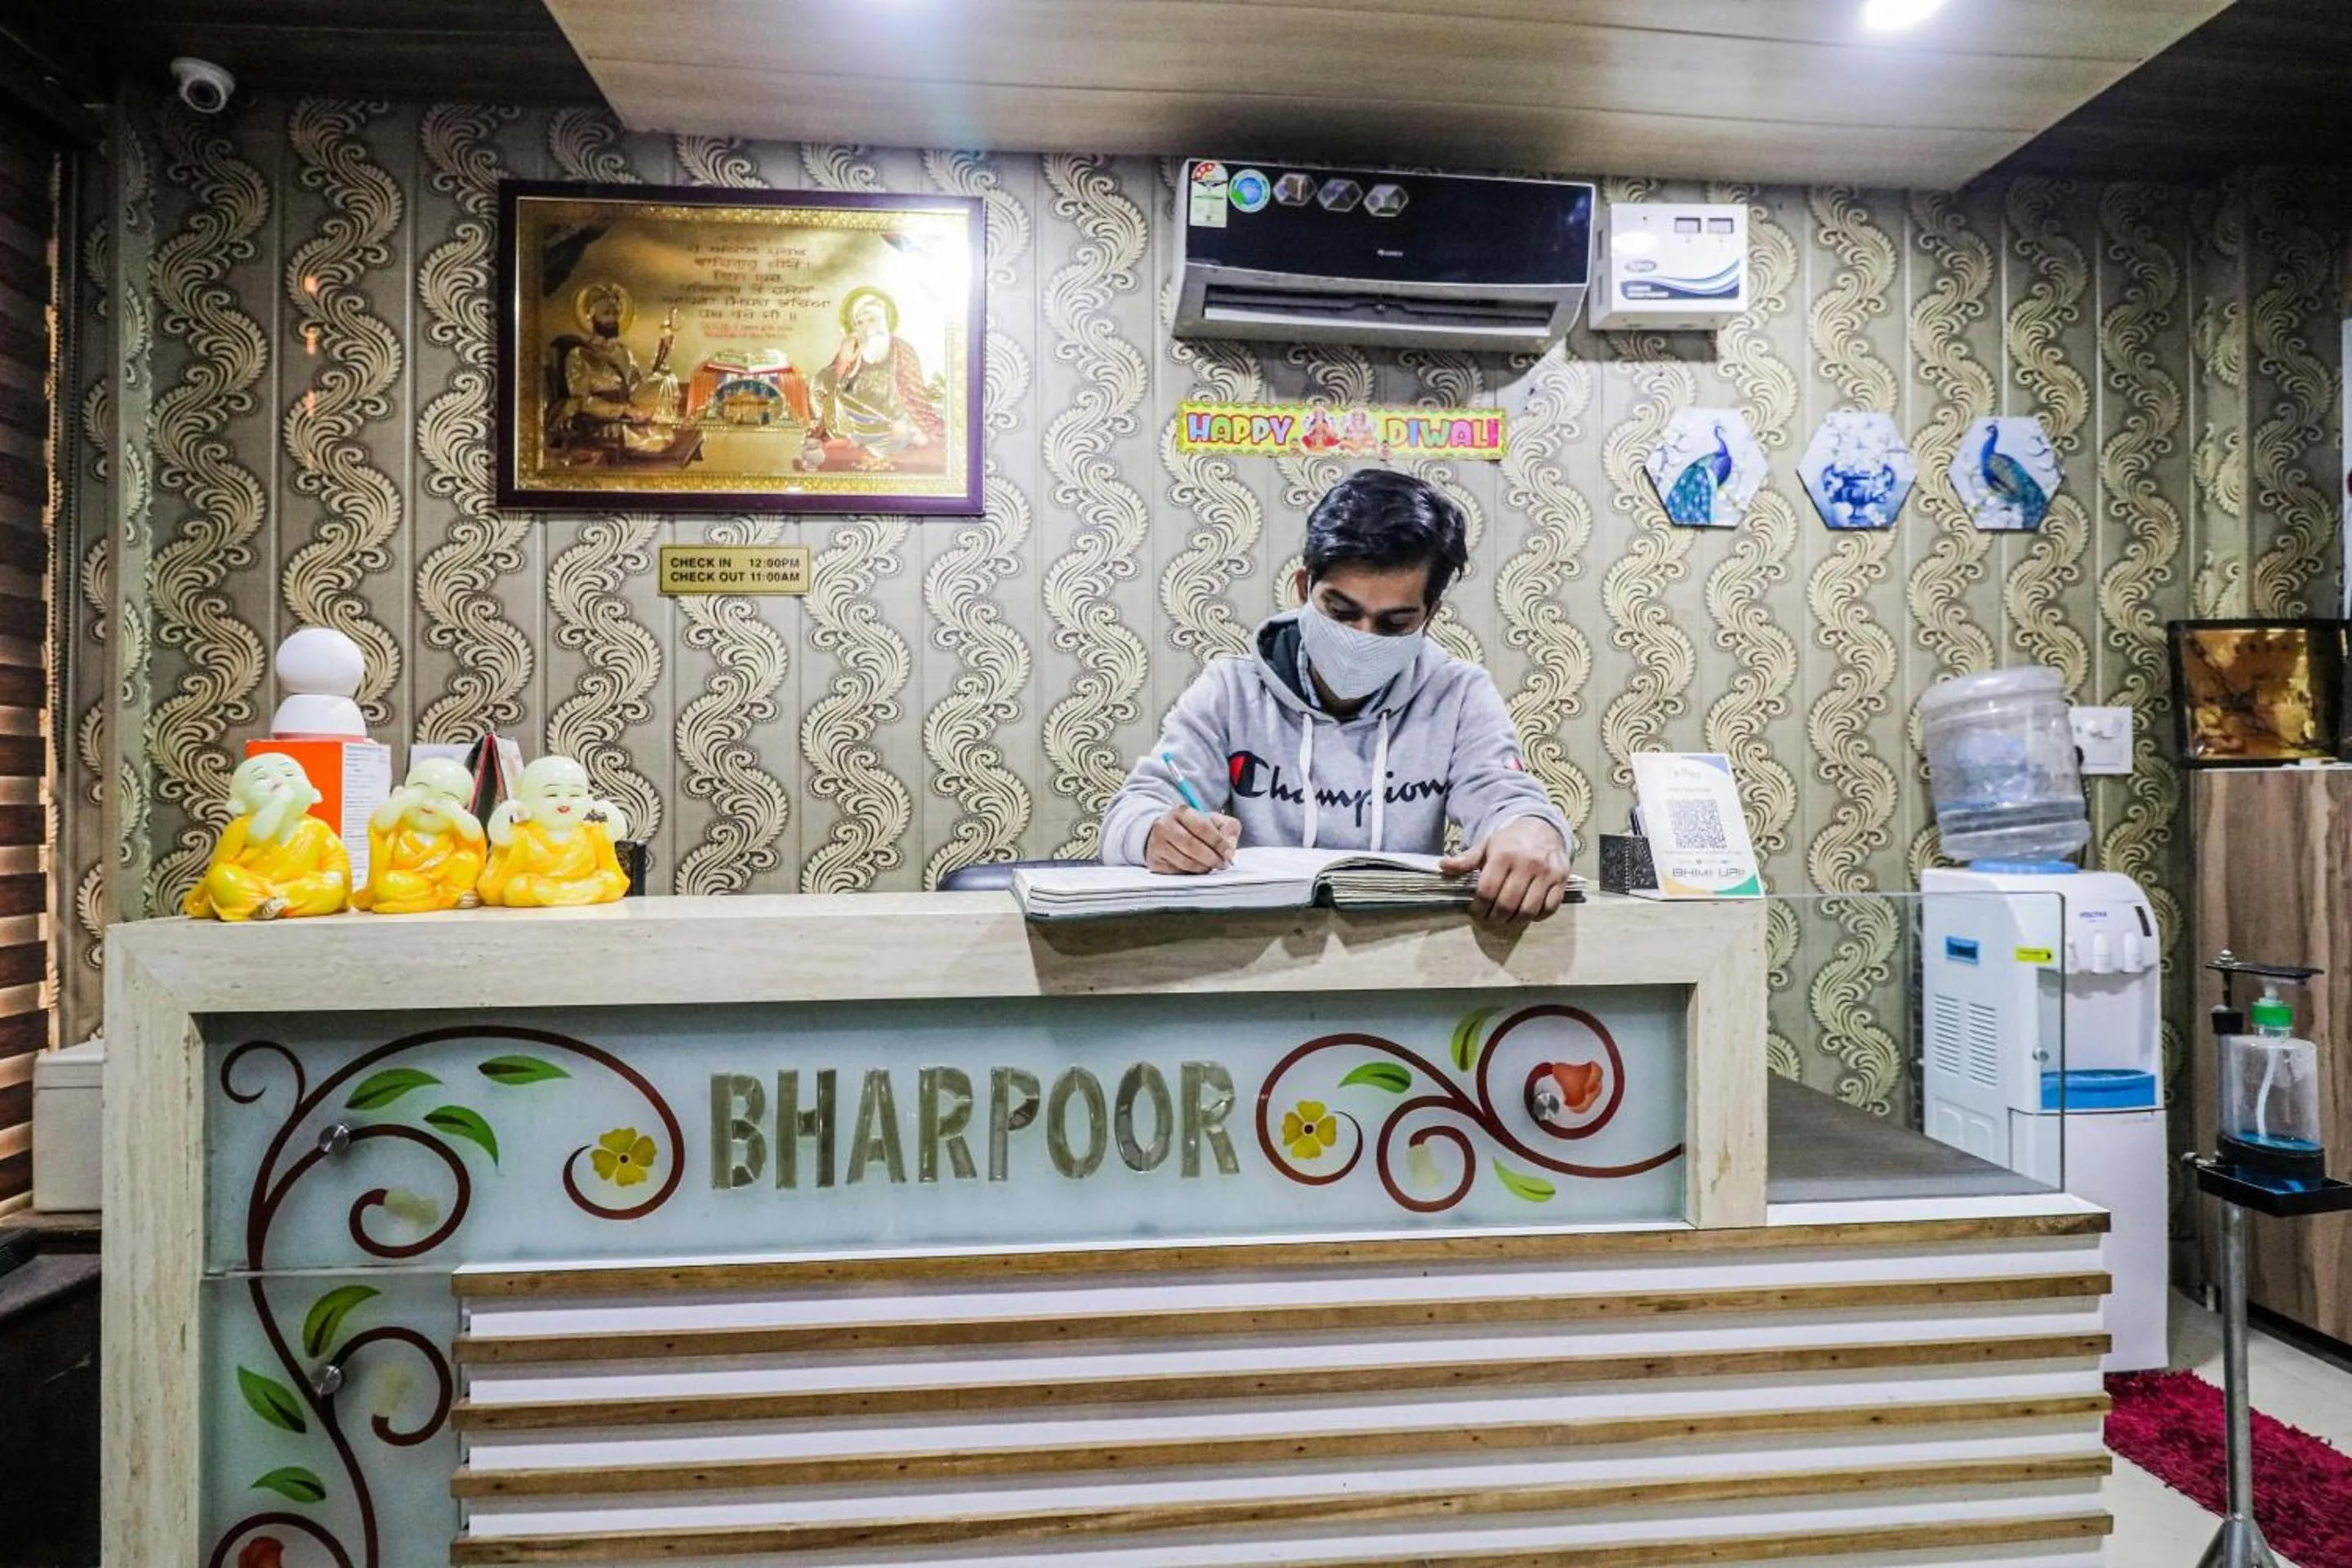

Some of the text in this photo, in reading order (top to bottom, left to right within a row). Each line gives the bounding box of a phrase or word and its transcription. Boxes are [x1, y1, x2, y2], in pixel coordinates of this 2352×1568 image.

[1187, 412, 1502, 449] HAPPY DIWALI
[670, 557, 800, 568] CHECK IN 12:00PM
[670, 572, 800, 582] CHECK OUT 11:00AM
[1228, 750, 1453, 828] Champion
[710, 1061, 1241, 1190] BHARPOOR
